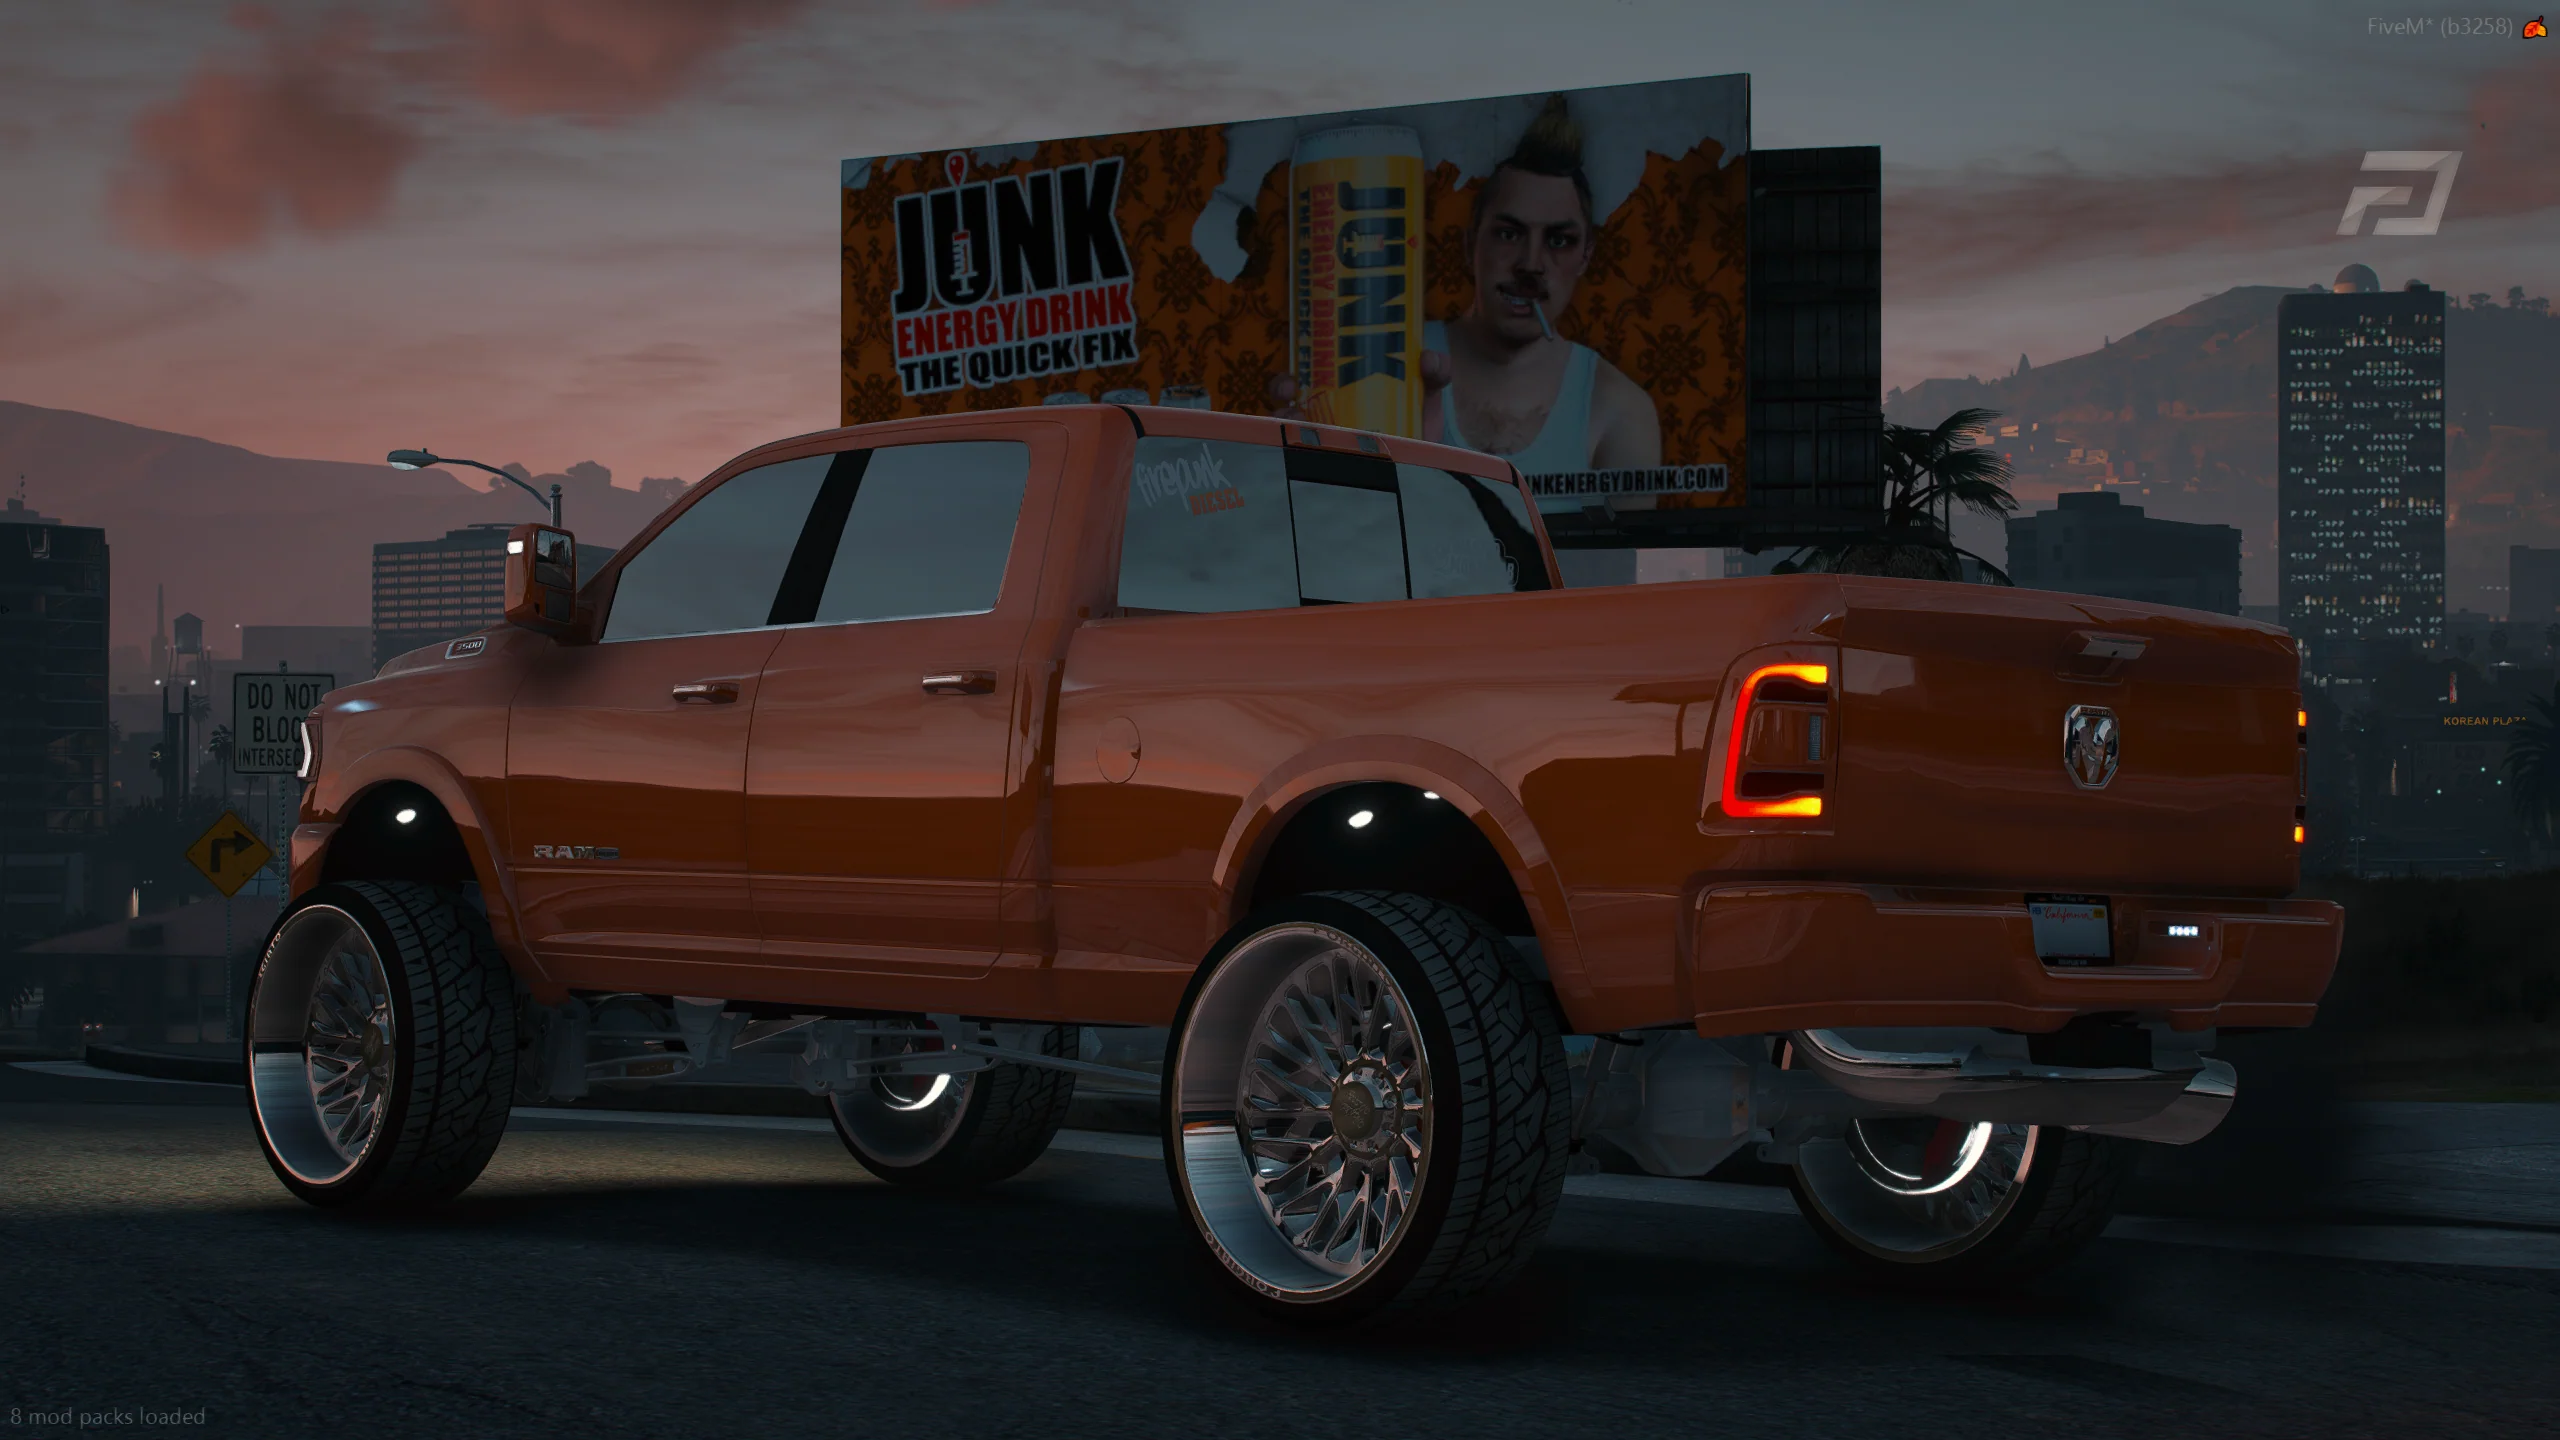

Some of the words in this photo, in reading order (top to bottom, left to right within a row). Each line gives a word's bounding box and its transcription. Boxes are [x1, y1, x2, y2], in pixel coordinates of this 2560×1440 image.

[895, 160, 1130, 314] JUNK
[1312, 183, 1335, 290] ENERGY
[1336, 182, 1406, 388] JUNK
[896, 301, 1022, 358] ENERGY
[1026, 283, 1133, 338] DRINK
[1312, 299, 1335, 389] DRINK
[900, 356, 960, 392] THE
[968, 338, 1075, 384] QUICK
[1082, 329, 1135, 365] FIX
[1136, 443, 1231, 512] firepunk
[1189, 485, 1245, 516] DIESEL
[247, 683, 273, 710] DO
[285, 683, 321, 710] NOT
[2443, 716, 2489, 726] KOREAN
[238, 747, 305, 767] INTERSEC
[253, 716, 307, 743] BLOC
[533, 844, 595, 860] RAM
[2045, 906, 2091, 924] California
[1205, 1231, 1281, 1298] FORGIATO
